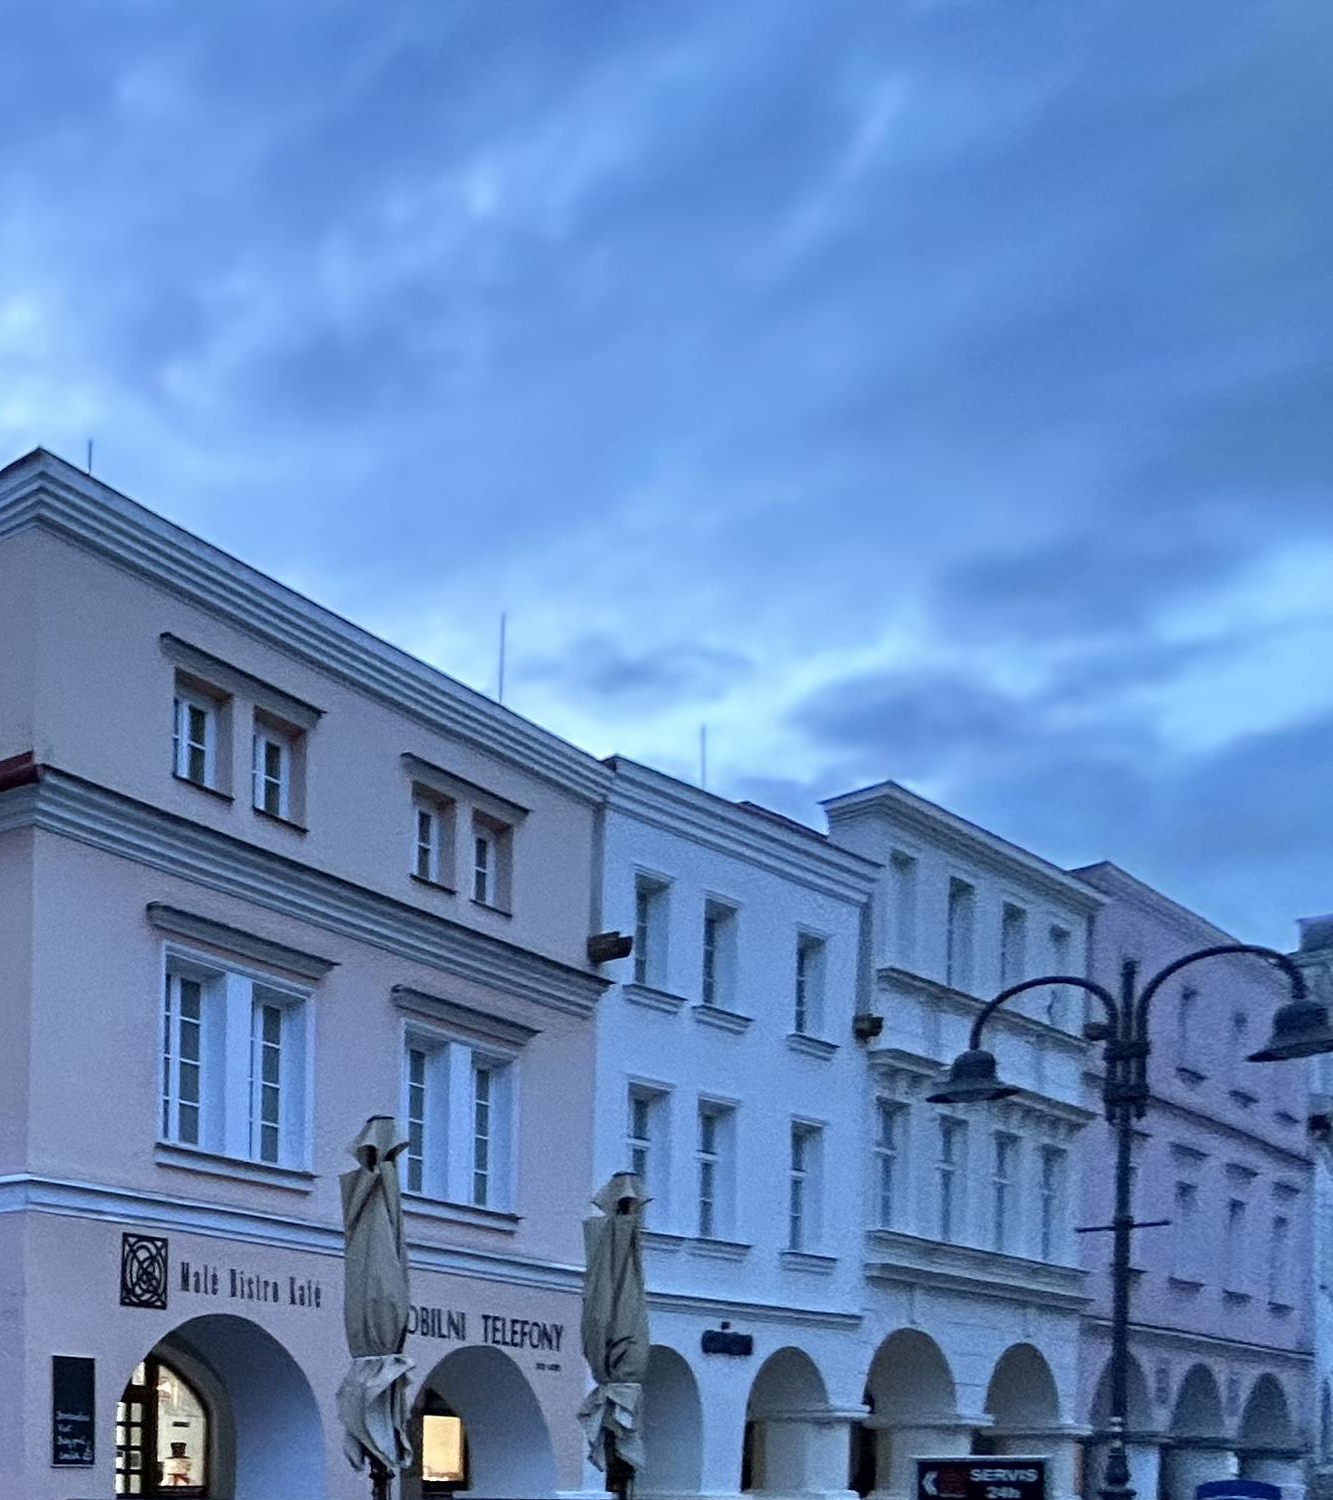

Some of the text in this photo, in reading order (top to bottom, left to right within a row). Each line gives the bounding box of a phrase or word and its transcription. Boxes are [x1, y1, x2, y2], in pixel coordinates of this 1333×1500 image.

[229, 1268, 279, 1303] Bistro
[481, 1314, 565, 1351] TELEFONY
[970, 1469, 1038, 1482] SERVIS
